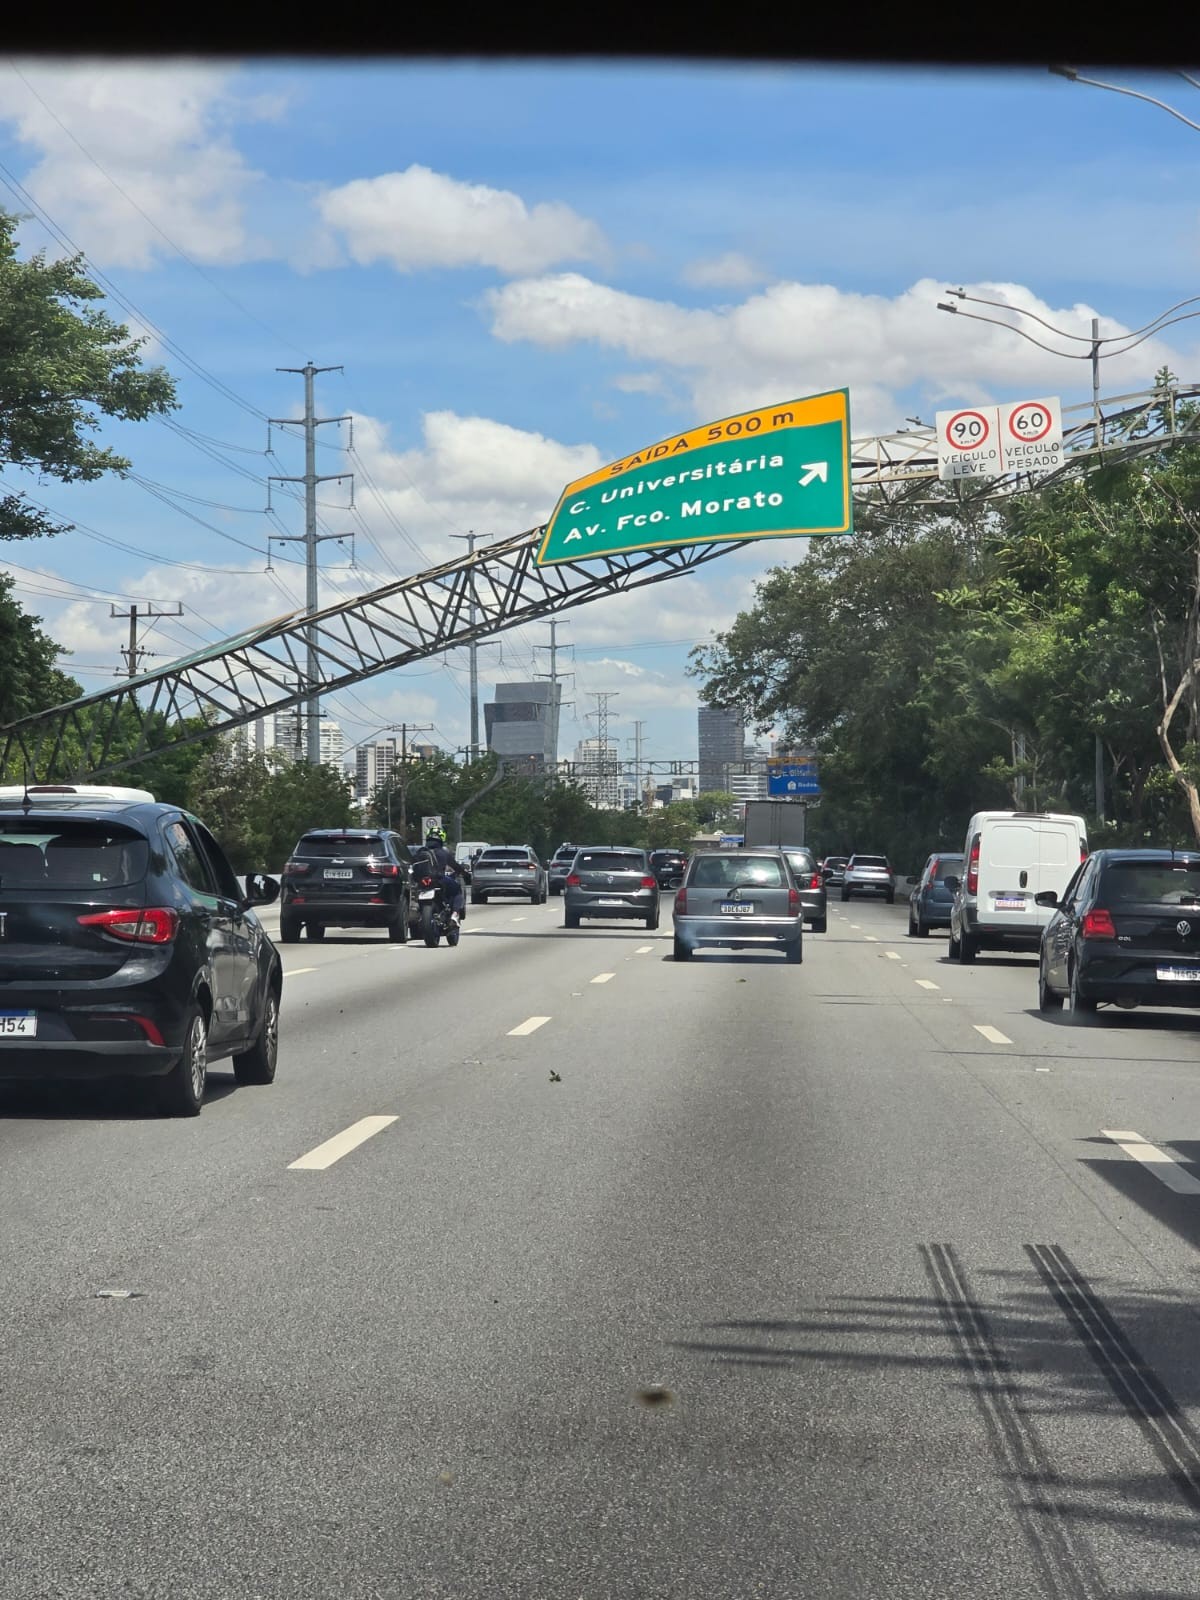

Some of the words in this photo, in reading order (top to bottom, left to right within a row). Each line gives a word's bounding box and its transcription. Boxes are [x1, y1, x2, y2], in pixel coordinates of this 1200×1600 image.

[954, 421, 981, 438] 90
[1017, 413, 1043, 430] 60
[609, 439, 689, 475] SAÍDA
[707, 416, 761, 441] 500
[773, 411, 794, 427] m
[1005, 443, 1059, 457] VEÍCULO
[942, 450, 996, 464] VEÍCULO
[1007, 456, 1058, 469] PESADO
[954, 464, 986, 475] LEVE
[569, 501, 591, 515] C.
[600, 455, 783, 503] Universitária
[563, 524, 606, 544] Av.
[617, 509, 670, 531] Fco.
[681, 491, 783, 518] Morato
